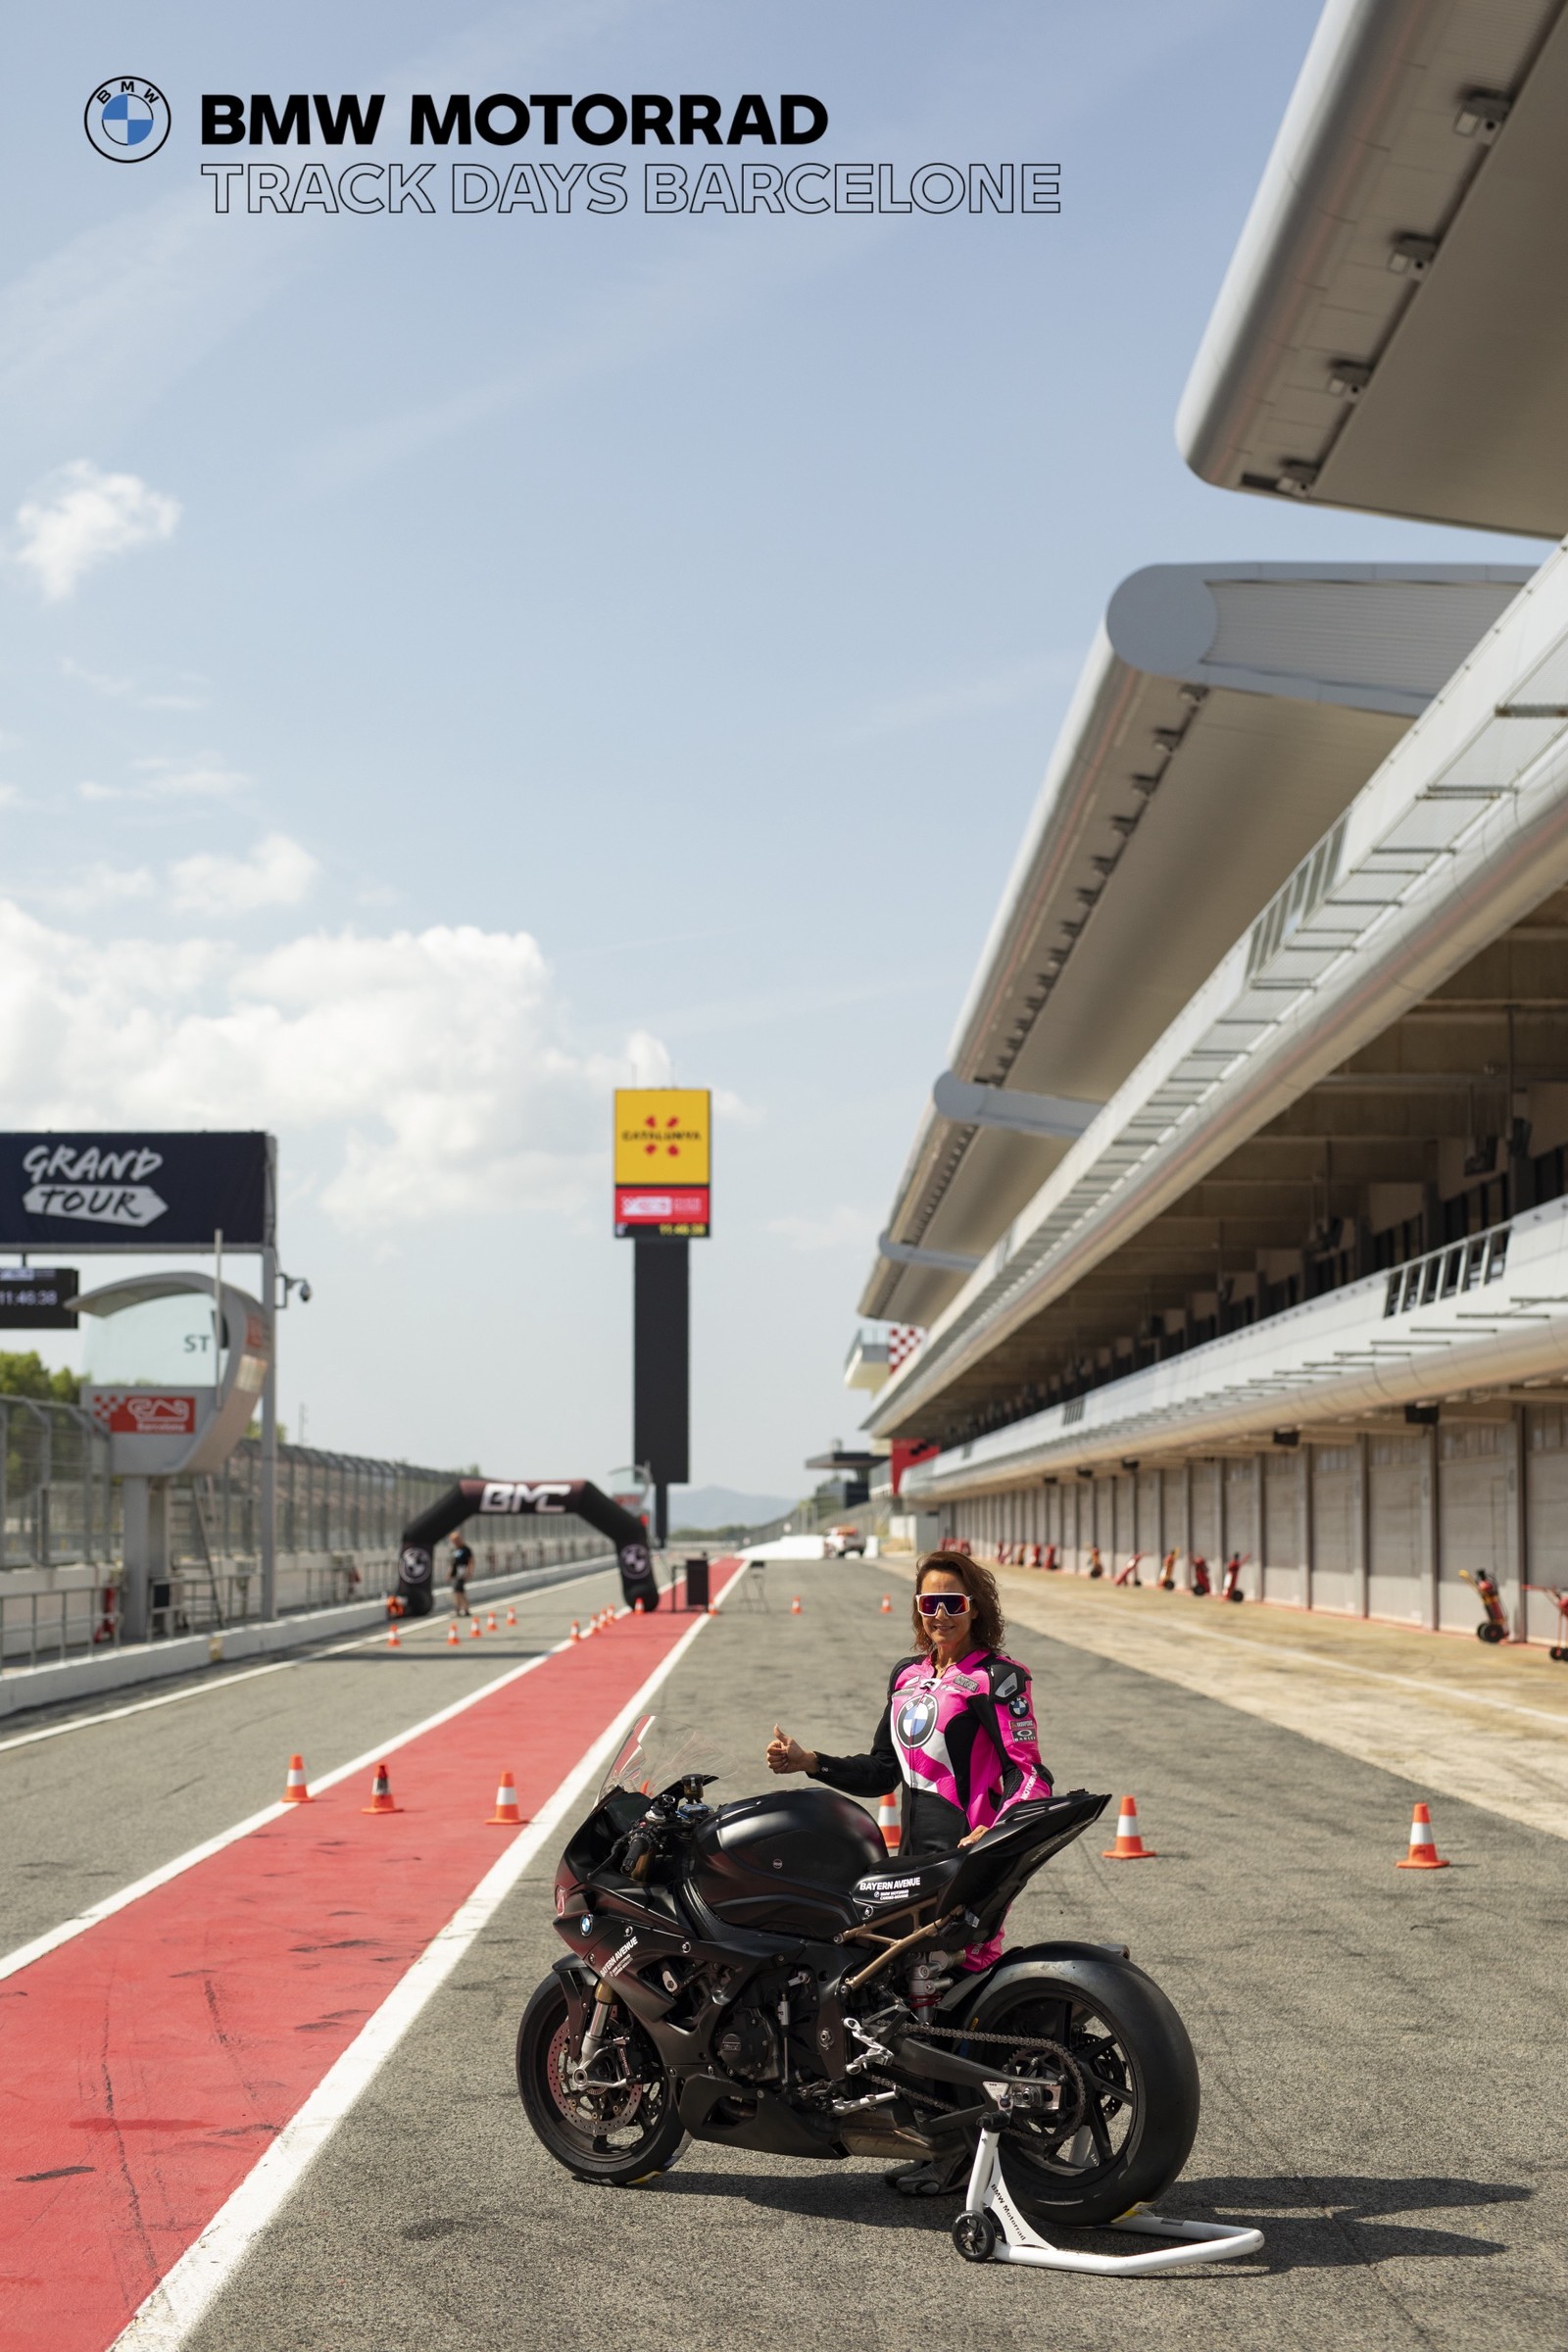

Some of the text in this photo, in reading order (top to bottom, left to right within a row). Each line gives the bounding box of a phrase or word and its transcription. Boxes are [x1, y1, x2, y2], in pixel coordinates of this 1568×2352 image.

[23, 1145, 164, 1184] GRAND
[39, 1188, 143, 1220] TOUR
[479, 1482, 572, 1513] BMC
[859, 1877, 921, 1891] BAYERN AVENUE
[614, 1936, 639, 1962] AVENUE
[991, 2183, 1027, 2241] BMW Motorrad
